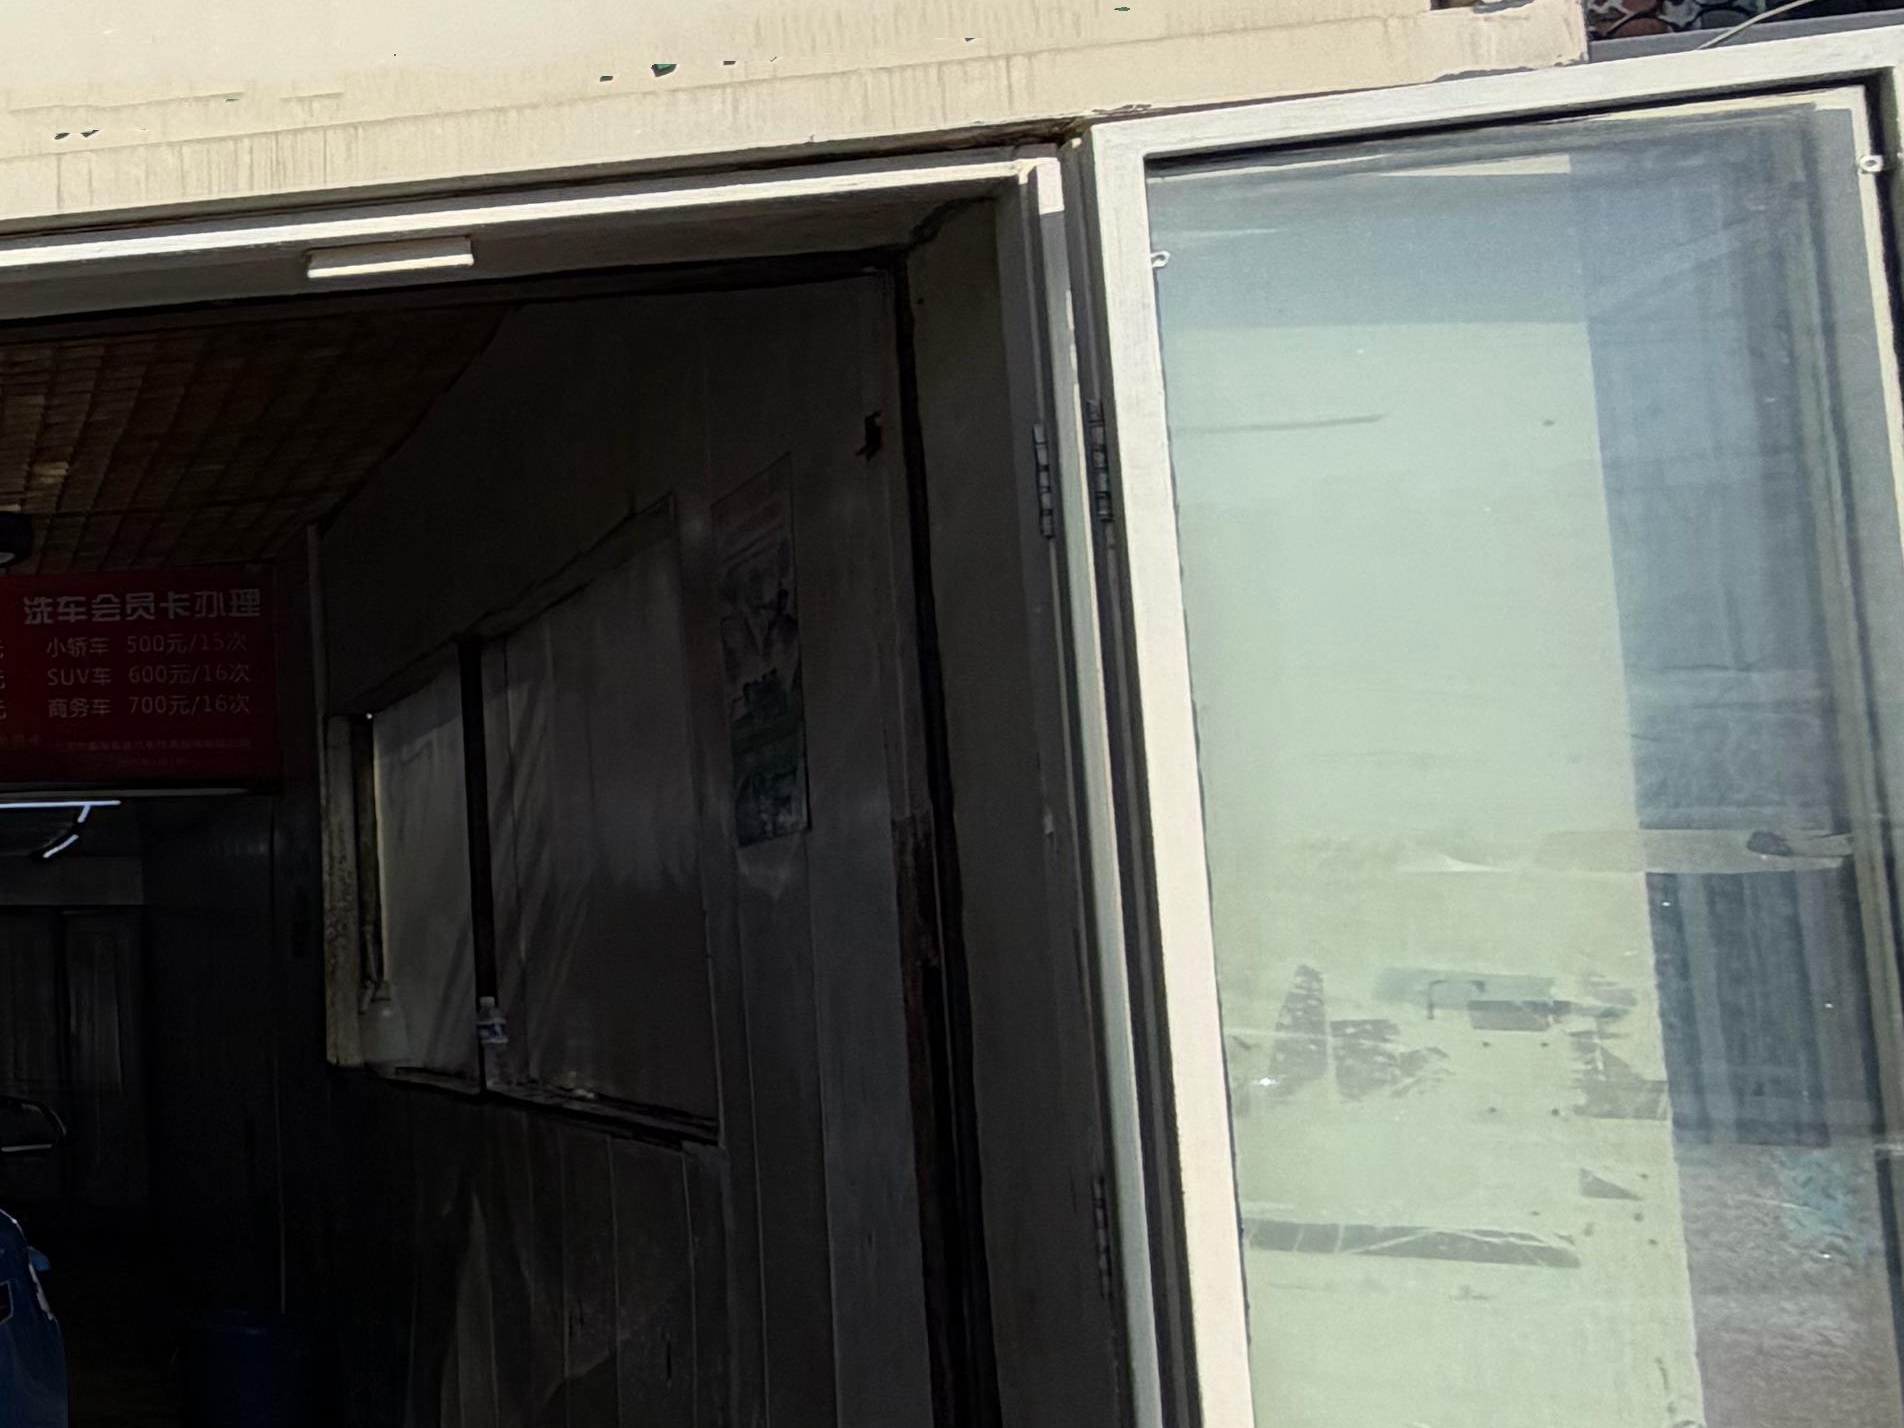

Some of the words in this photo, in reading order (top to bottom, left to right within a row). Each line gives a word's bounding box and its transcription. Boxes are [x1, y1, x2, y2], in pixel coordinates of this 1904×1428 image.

[23, 587, 262, 625] 洗车会员卡办理
[126, 632, 248, 654] 500元/15次
[47, 668, 112, 686] SUV车
[128, 663, 250, 685] 600元/16次
[48, 697, 112, 719] 商务车
[128, 693, 250, 716] 700元/16次
